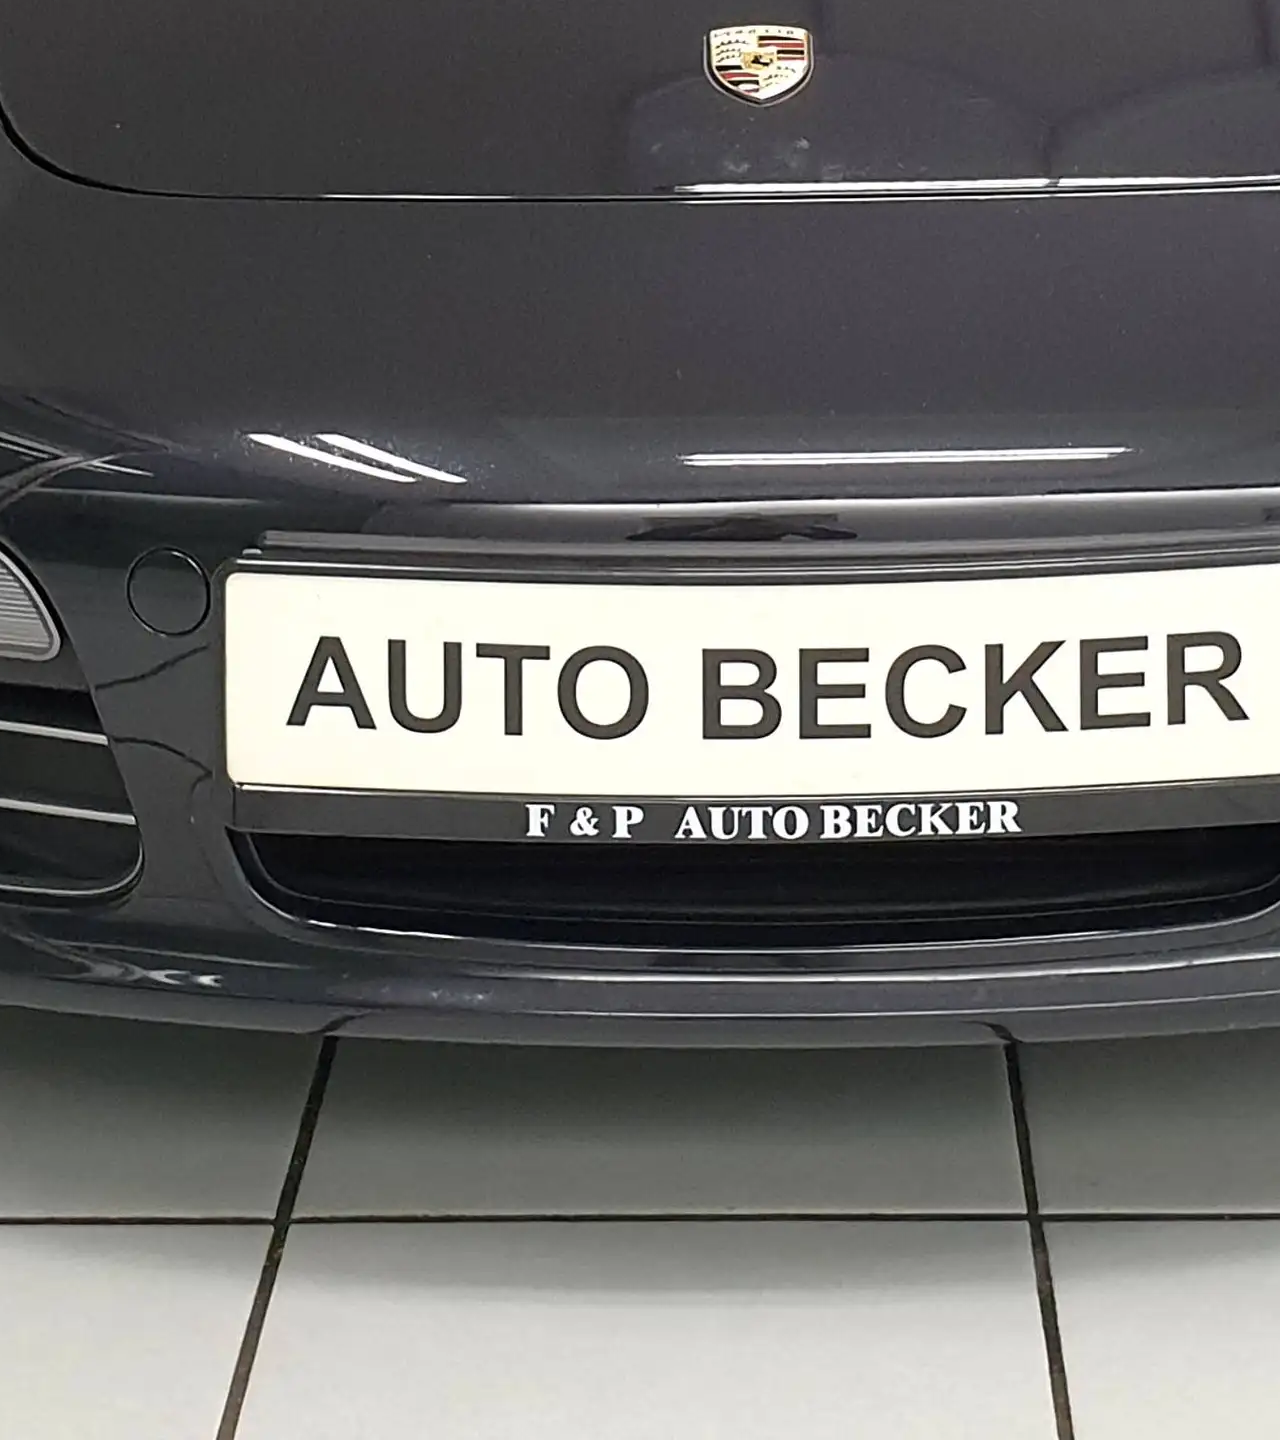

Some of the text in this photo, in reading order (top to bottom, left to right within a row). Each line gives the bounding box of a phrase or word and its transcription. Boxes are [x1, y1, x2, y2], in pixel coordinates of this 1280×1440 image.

[285, 631, 1250, 741] AUTO BECKER
[525, 800, 1022, 840] F & P AUTO BECKER
